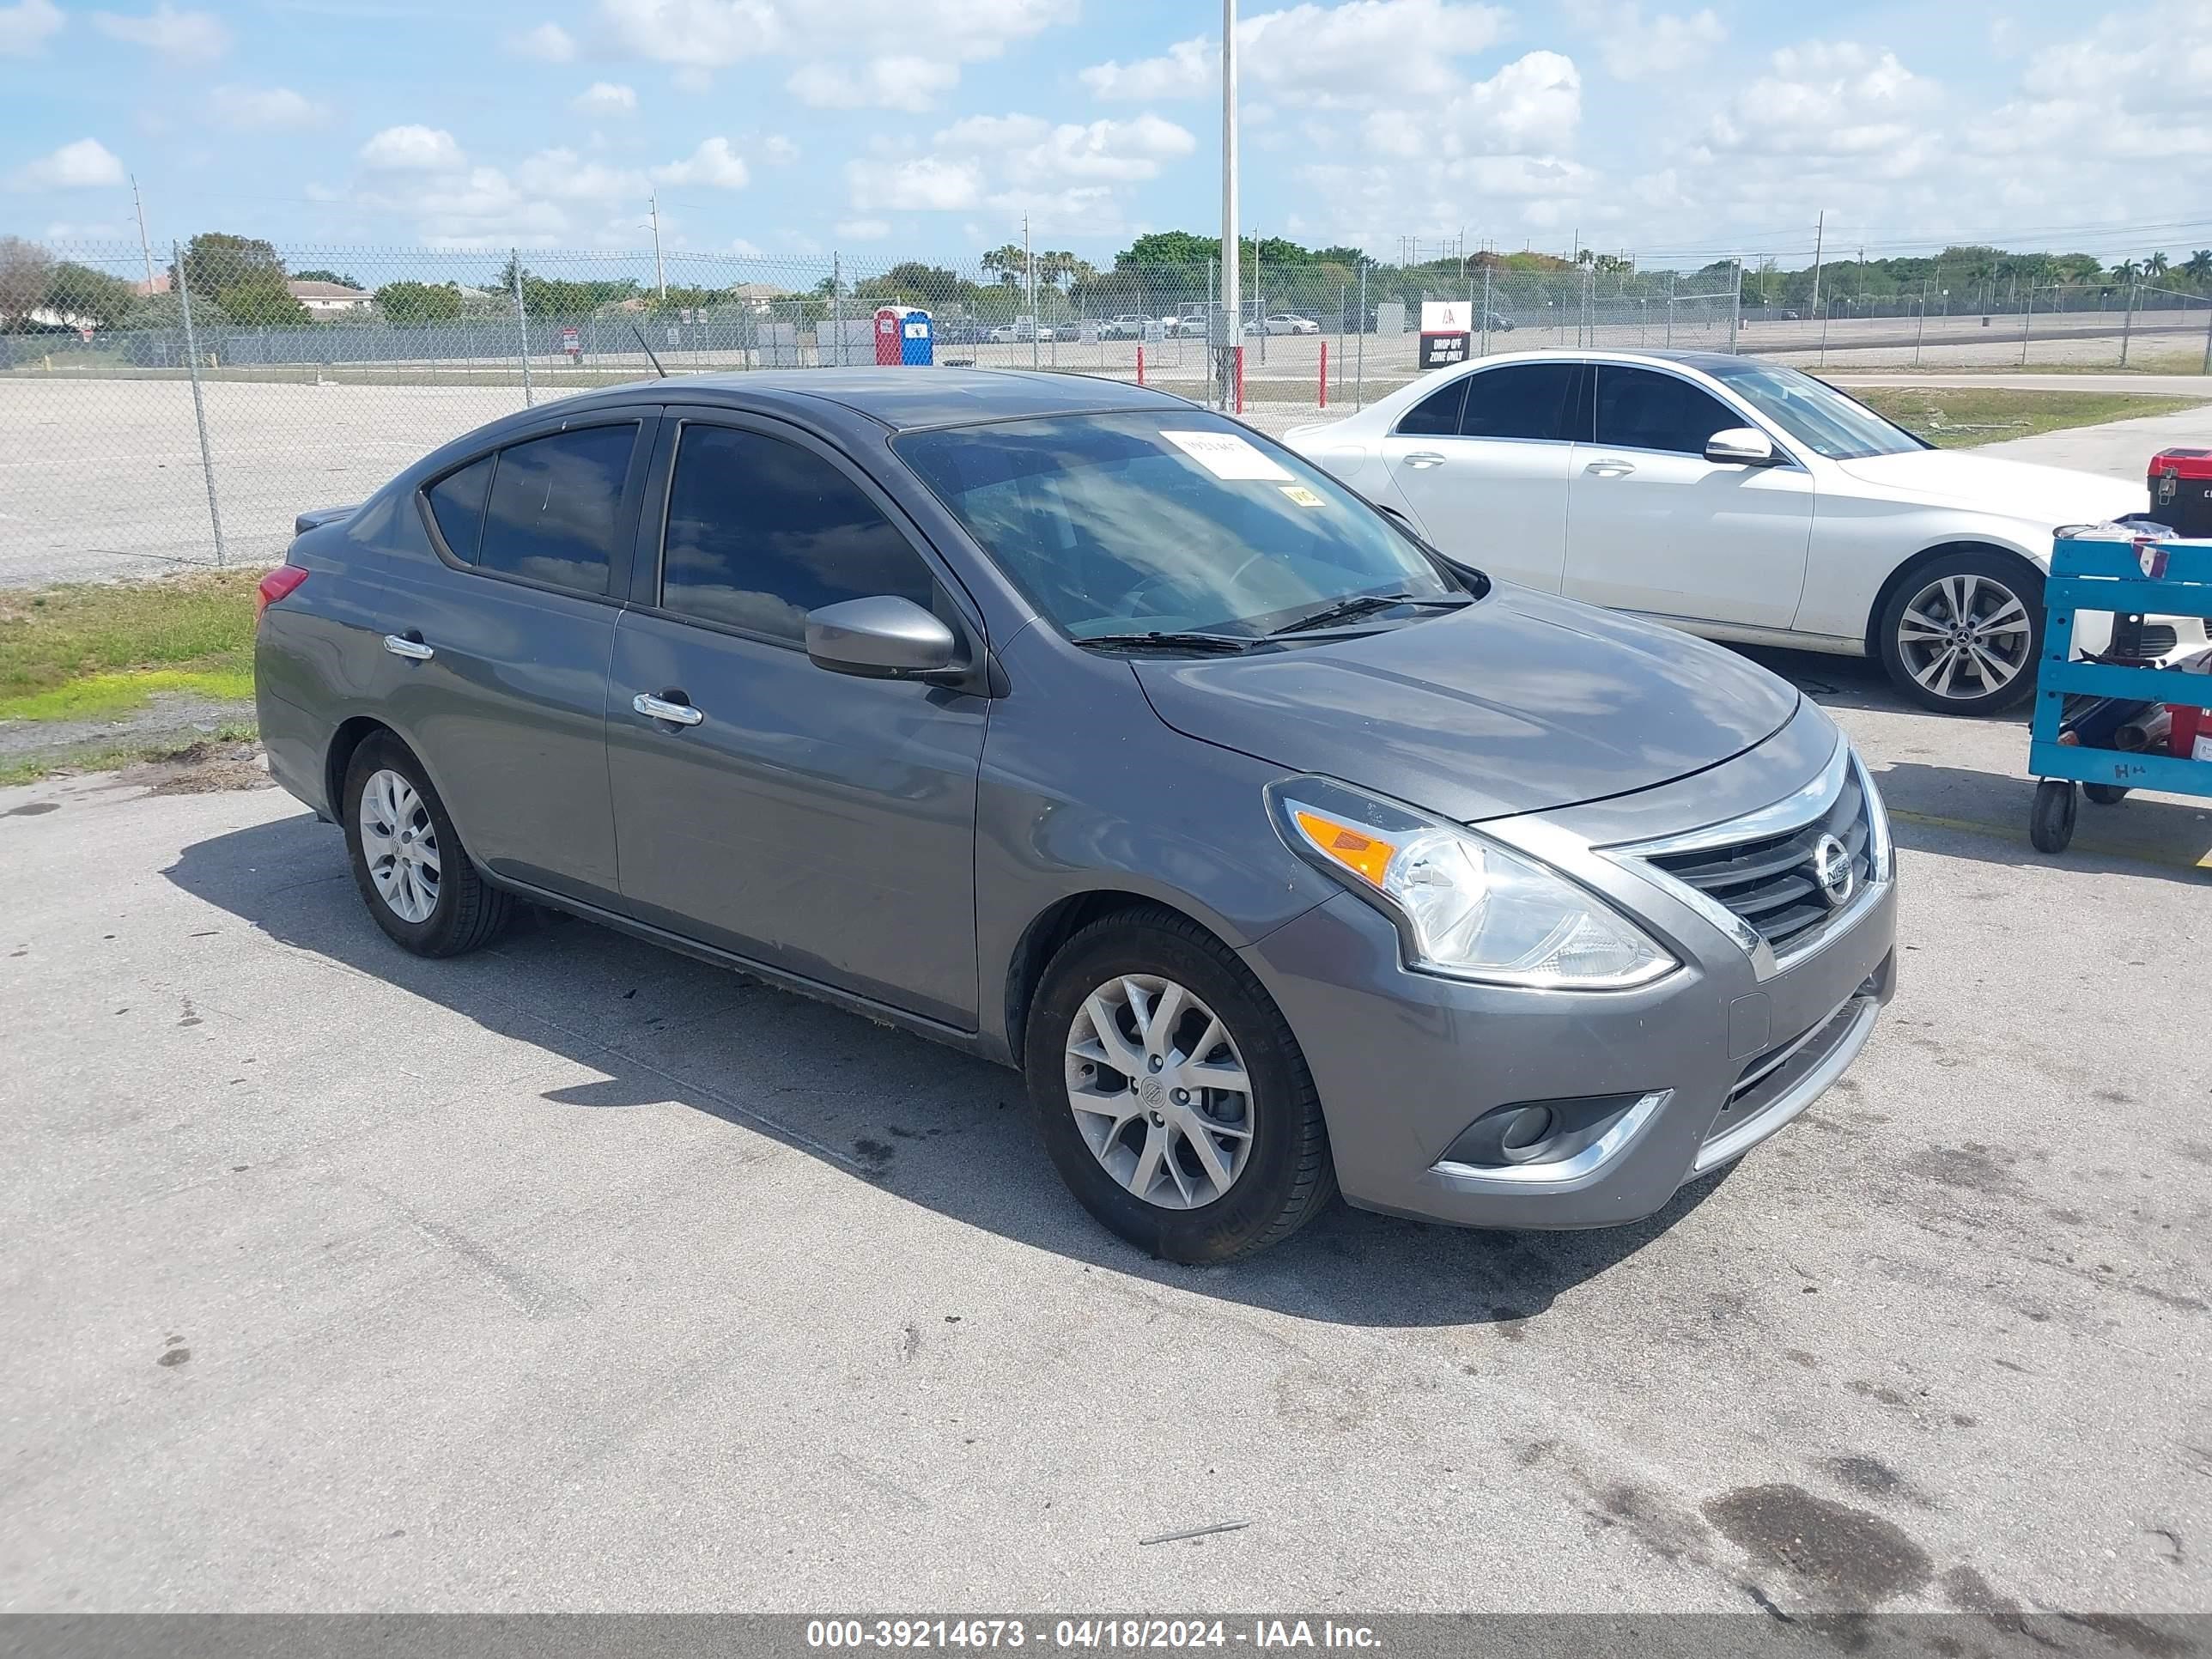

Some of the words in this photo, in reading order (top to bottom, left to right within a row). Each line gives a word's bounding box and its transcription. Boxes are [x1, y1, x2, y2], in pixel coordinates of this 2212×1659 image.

[1433, 338, 1450, 350] DROP
[1451, 337, 1462, 349] OFF
[1429, 350, 1447, 362] ZONE
[1447, 349, 1464, 362] ONLY
